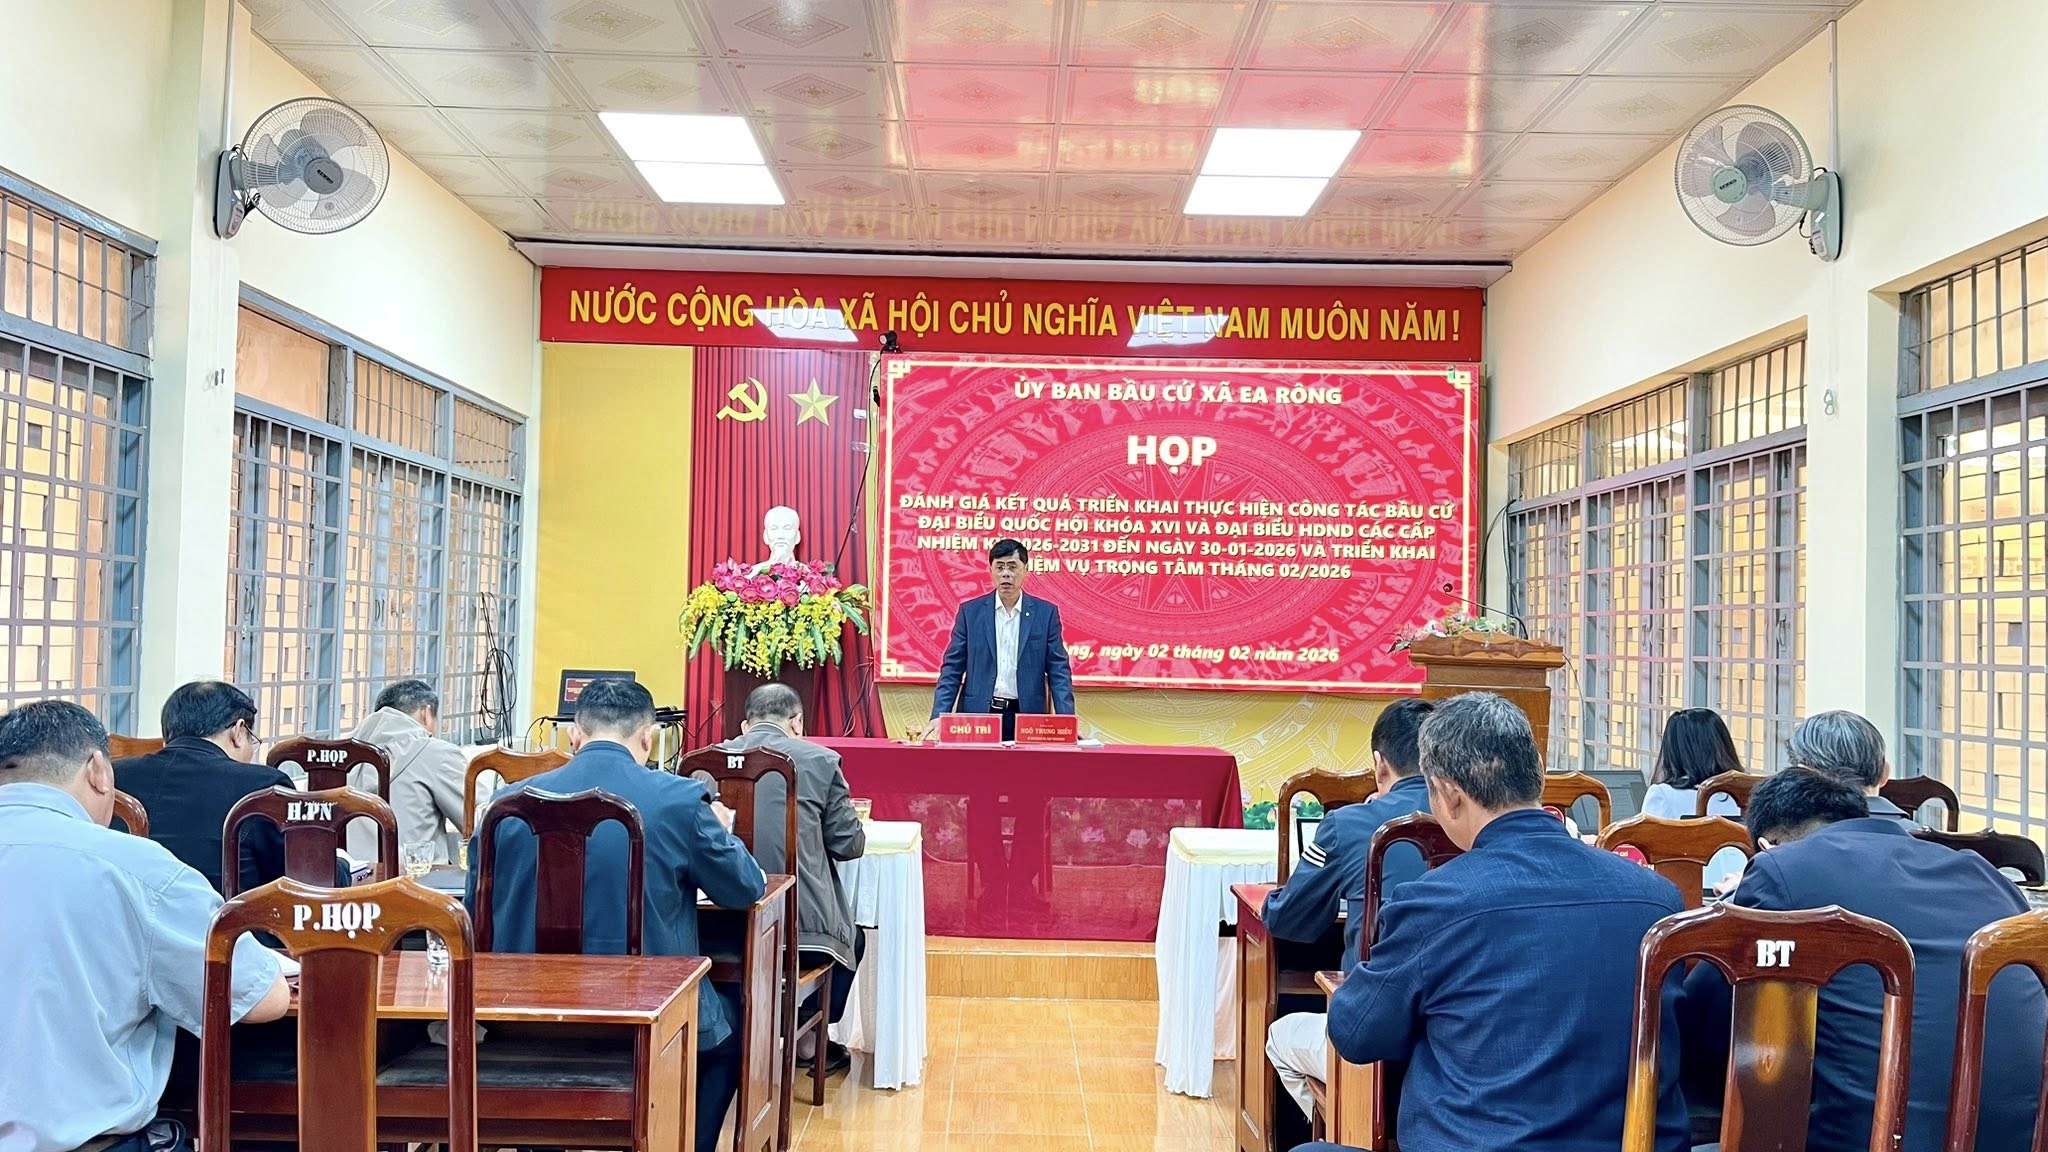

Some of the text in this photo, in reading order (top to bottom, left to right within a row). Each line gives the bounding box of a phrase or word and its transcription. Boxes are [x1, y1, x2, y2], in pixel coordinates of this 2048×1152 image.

[569, 283, 656, 325] NƯỚC
[667, 285, 754, 332] CỘNG
[766, 288, 829, 329] HÒA
[839, 292, 879, 331] XÃ
[888, 291, 939, 338] HỘI
[949, 290, 1012, 335] CHỦ
[1023, 297, 1118, 337] NGHĨA
[1127, 297, 1195, 344] VIỆT
[1204, 306, 1270, 340] NAM
[1280, 301, 1369, 341] MUÔN
[1014, 374, 1046, 399] ỦY
[1051, 382, 1101, 401] BAN
[1107, 377, 1156, 401] BẦU
[1201, 381, 1233, 403] XÃ
[1240, 386, 1268, 404] EA
[1275, 383, 1342, 405] RÔNG
[1127, 435, 1217, 474] HỌP
[900, 494, 954, 509] ĐÁNH
[959, 494, 990, 510] GIÁ
[996, 493, 1028, 510] KẾT
[1033, 494, 1072, 512] QUẢ
[1077, 494, 1129, 513] TRIỂN
[1134, 500, 1179, 514] KHAI
[1184, 501, 1235, 518] THỰC
[1240, 499, 1283, 519] HIỆN
[1288, 500, 1340, 517] CÔNG
[1345, 501, 1382, 518] TÁC
[1386, 500, 1424, 519] BẦU
[918, 512, 1436, 540] ĐẠI BIỂU QUỐC HỘI KHÓA XVI VÀ ĐẠI BIỂU HDND CÁC CẤP
[918, 534, 978, 554] NHIỆM
[1103, 536, 1141, 553] ĐẾN
[1146, 538, 1196, 555] NGÀY
[1200, 542, 1297, 558] 30-01-2026
[1301, 541, 1327, 558] VÀ
[1331, 540, 1385, 560] TRIỂN
[1390, 546, 1436, 560] KHAI
[1027, 556, 1352, 579] IỆM VỤ TRỌNG TÂM THÁNG 02/2026
[1100, 643, 1144, 661] ngày
[1147, 644, 1170, 658] 02
[1173, 644, 1225, 663] tháng
[1229, 646, 1250, 660] 02
[1254, 648, 1294, 661] năm
[1297, 648, 1340, 662] 2026
[306, 749, 348, 767] P.HỌP
[727, 755, 745, 769] BT
[287, 802, 332, 821] H.PN
[293, 902, 381, 939] P.HỌP
[1756, 939, 1796, 967] BT
